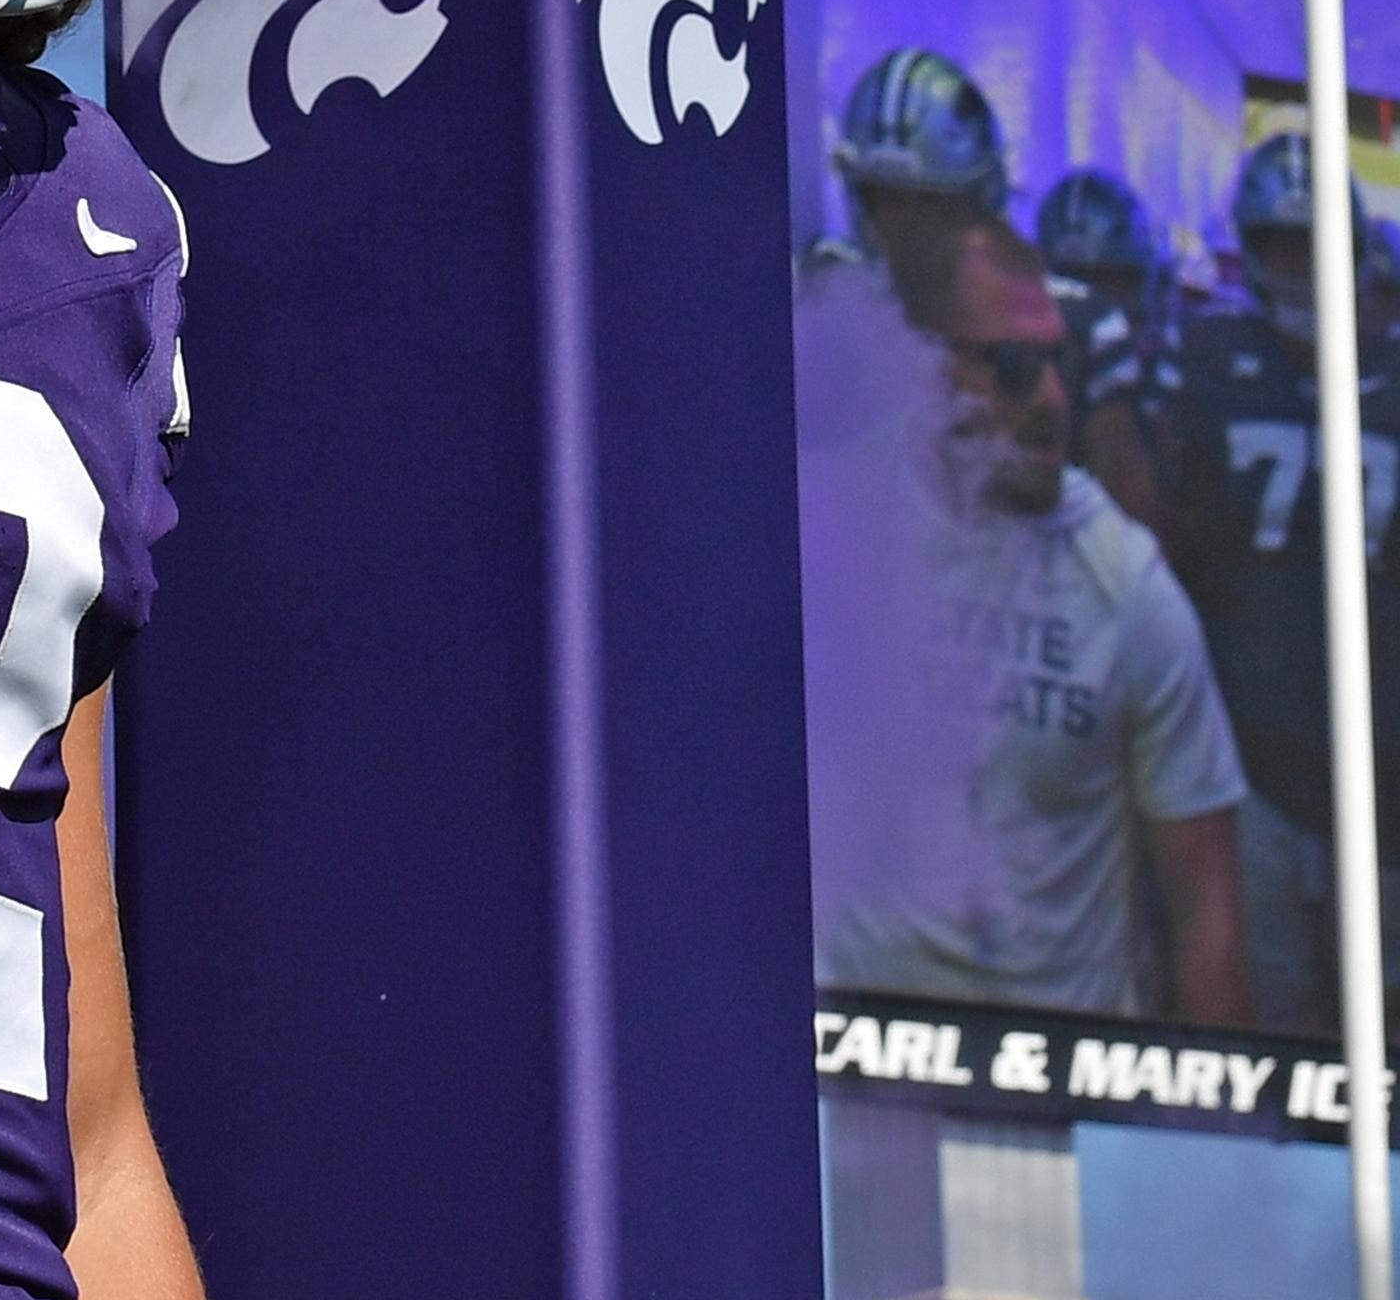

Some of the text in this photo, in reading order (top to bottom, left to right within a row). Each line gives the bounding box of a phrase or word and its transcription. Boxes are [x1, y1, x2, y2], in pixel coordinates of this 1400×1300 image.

[814, 1011, 1397, 1123] CARL & MARY IC
